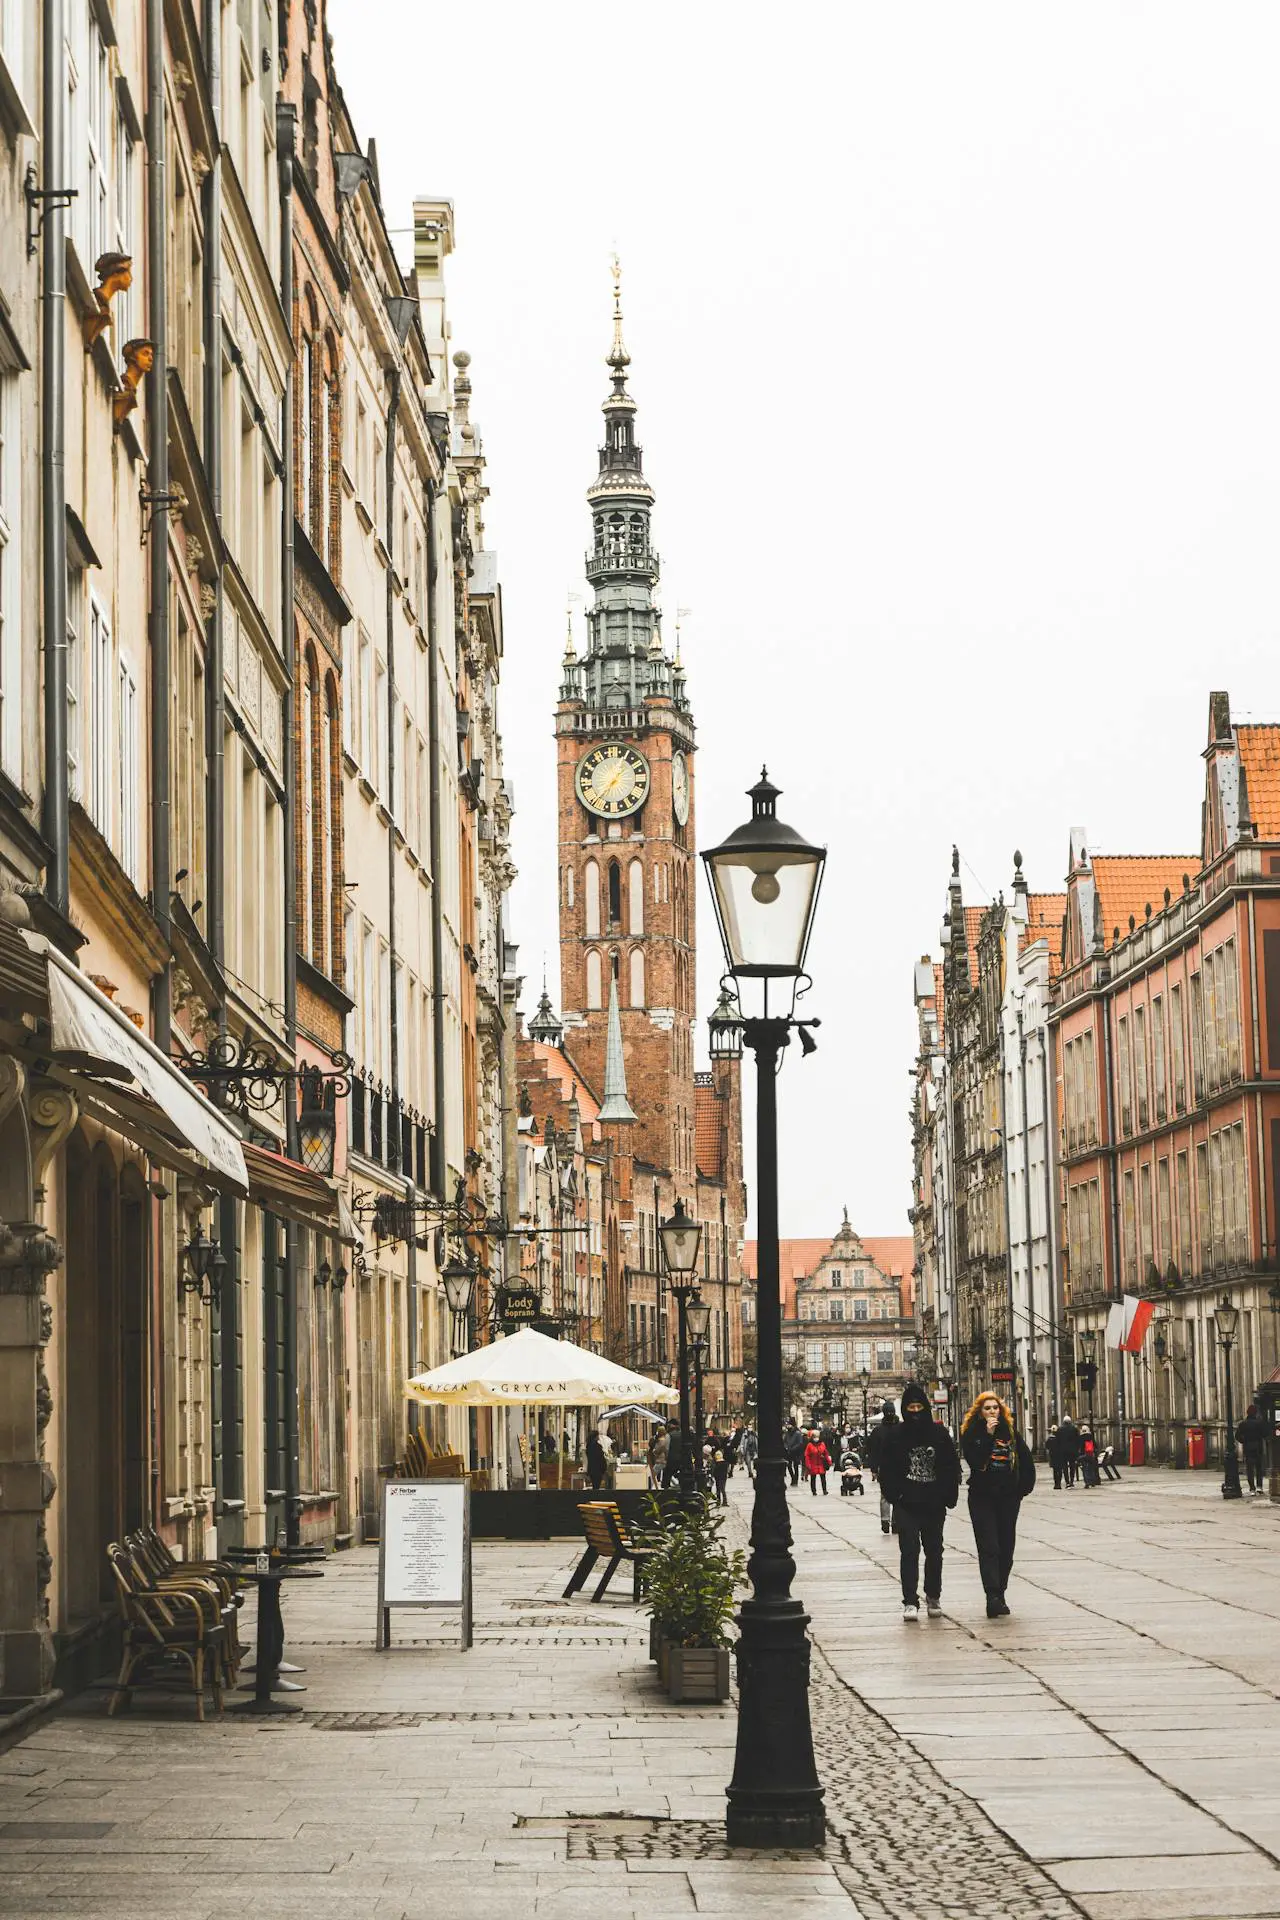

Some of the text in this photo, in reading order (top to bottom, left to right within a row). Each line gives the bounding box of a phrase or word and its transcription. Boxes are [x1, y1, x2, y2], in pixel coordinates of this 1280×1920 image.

[607, 746, 618, 758] XII
[584, 762, 594, 771] X
[631, 760, 642, 769] II
[580, 777, 592, 787] IX
[635, 773, 646, 782] III
[507, 1296, 533, 1310] Lody
[504, 1308, 536, 1319] Soprano
[501, 1383, 567, 1393] GRYCAN
